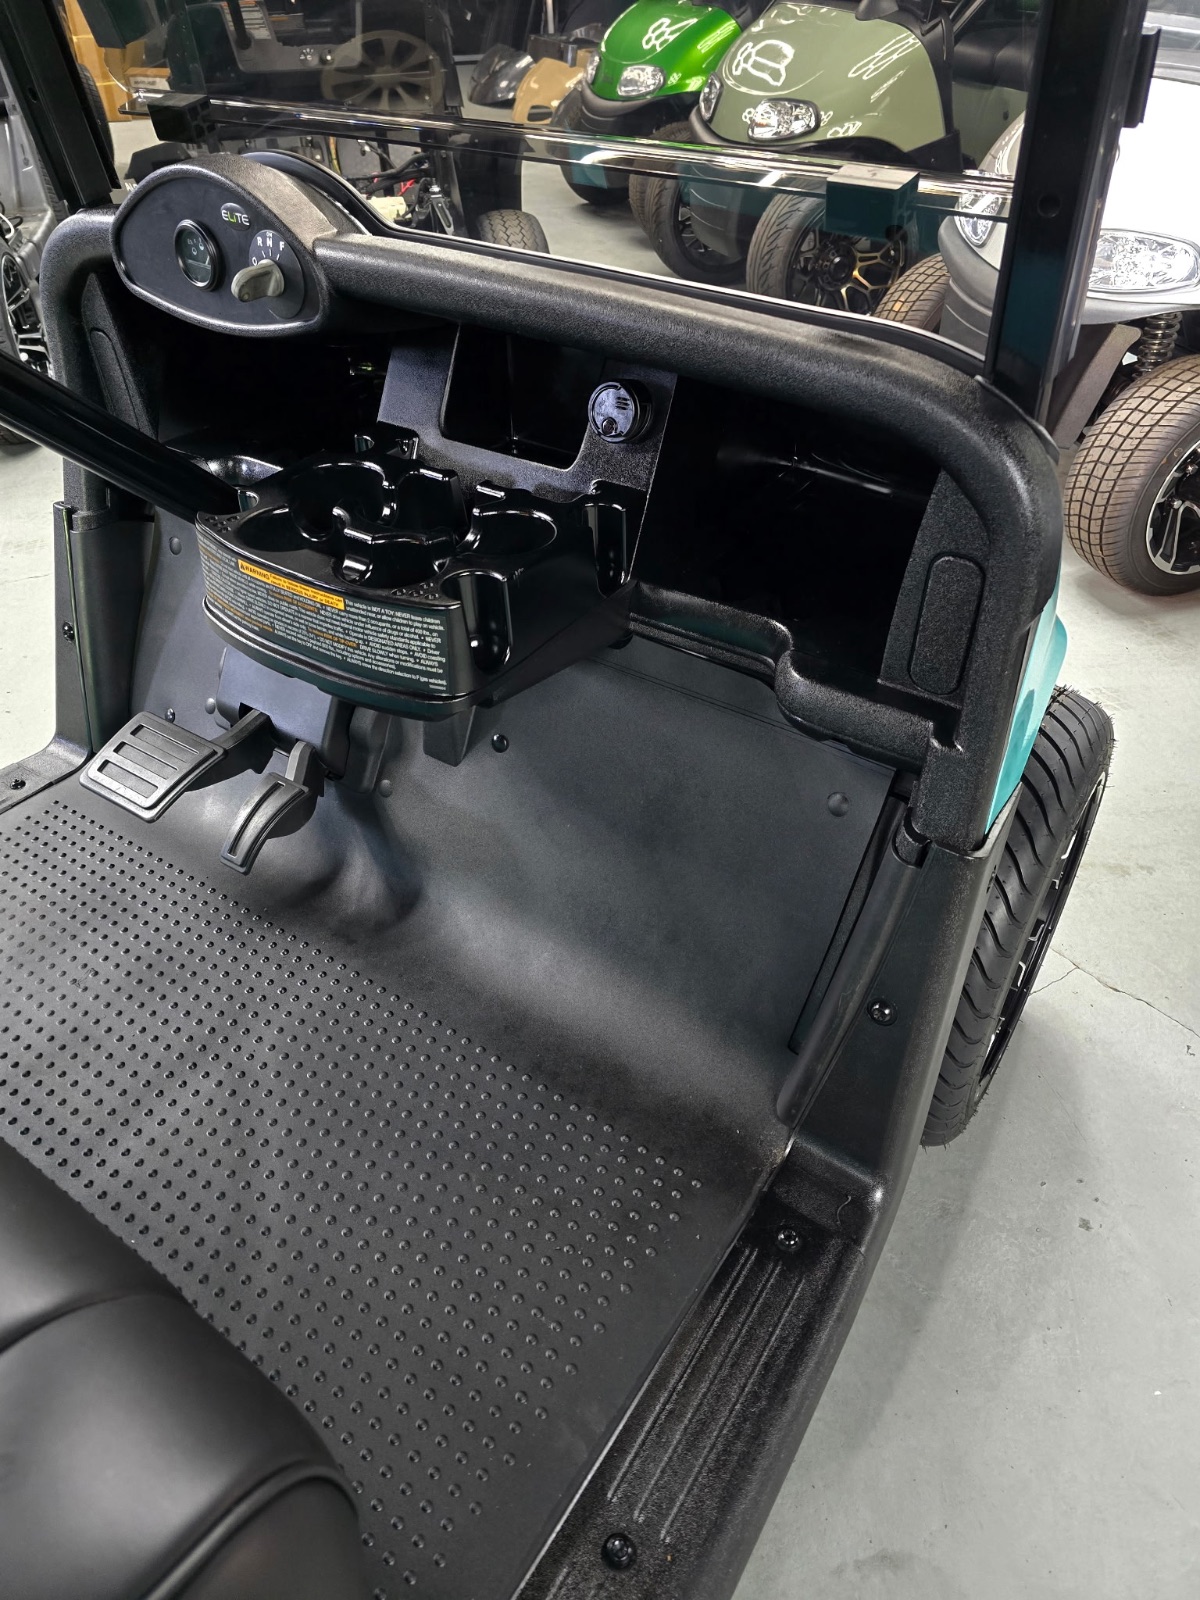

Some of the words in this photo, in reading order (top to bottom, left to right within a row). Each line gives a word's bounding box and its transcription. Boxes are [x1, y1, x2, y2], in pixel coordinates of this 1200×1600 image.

[257, 237, 263, 247] R
[280, 241, 285, 252] F
[244, 565, 270, 580] WARNING
[303, 592, 318, 600] INJURY
[392, 616, 408, 624] children
[368, 636, 394, 645] DESIGNATED
[410, 639, 429, 648] applicable
[427, 655, 445, 663] coasting
[400, 661, 425, 669] modifications
[378, 666, 394, 674] direction
